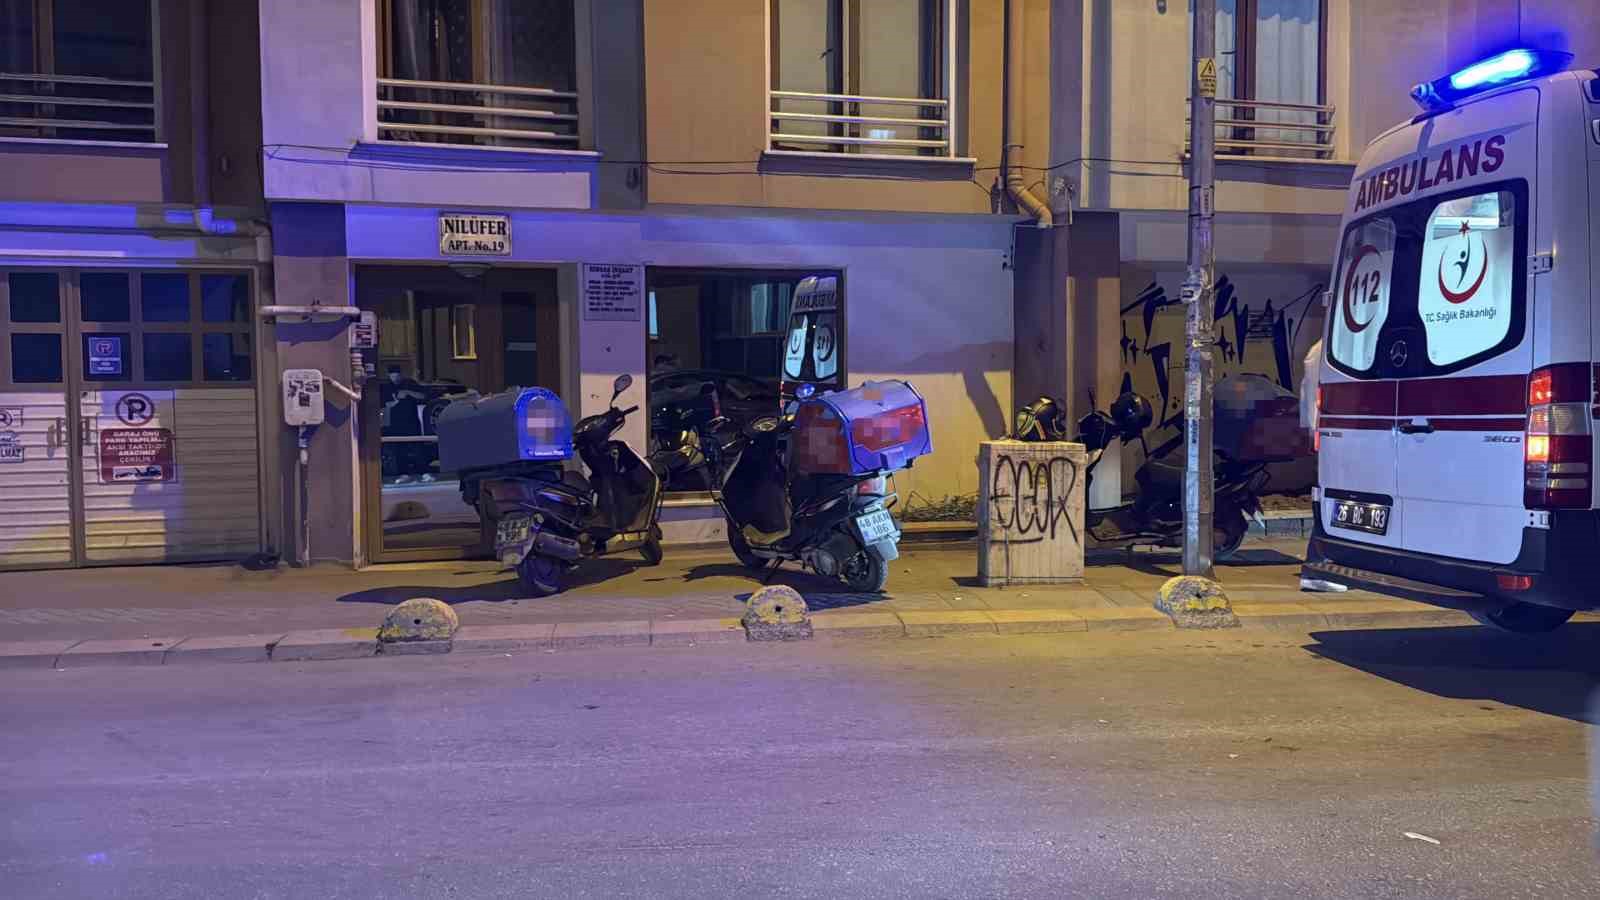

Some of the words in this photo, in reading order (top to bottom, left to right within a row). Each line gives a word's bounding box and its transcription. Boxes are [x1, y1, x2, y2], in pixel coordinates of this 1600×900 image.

[1354, 134, 1506, 213] AMBULANS
[444, 215, 507, 235] NİLÜFER
[1352, 270, 1381, 306] 112
[1436, 311, 1458, 323] Sağlık
[1460, 306, 1496, 320] Bakanlığı
[1371, 508, 1387, 529] 193
